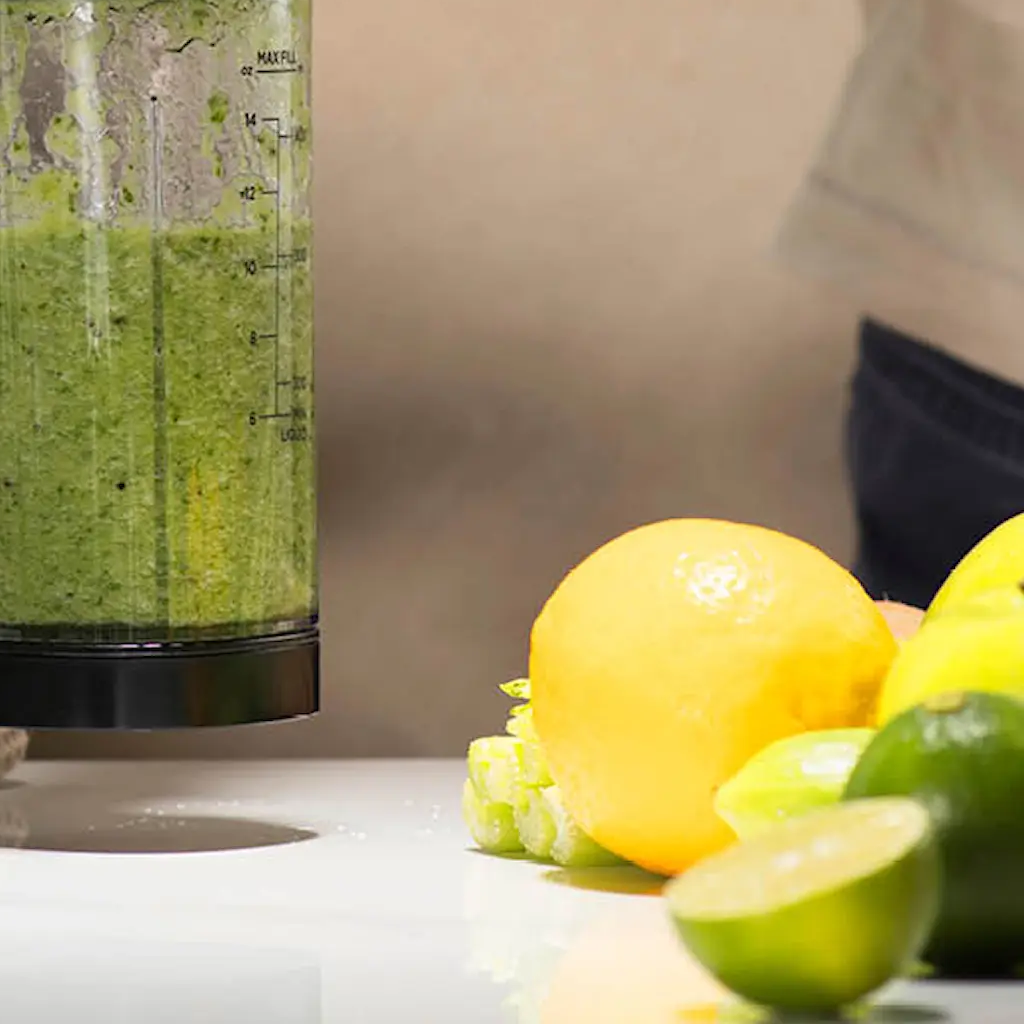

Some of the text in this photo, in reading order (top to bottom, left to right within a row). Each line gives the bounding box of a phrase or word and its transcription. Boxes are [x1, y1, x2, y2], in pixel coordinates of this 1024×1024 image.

[257, 51, 279, 65] MAX
[245, 113, 256, 127] 14
[244, 260, 256, 275] 10
[250, 330, 256, 345] 8
[249, 411, 256, 426] 6
